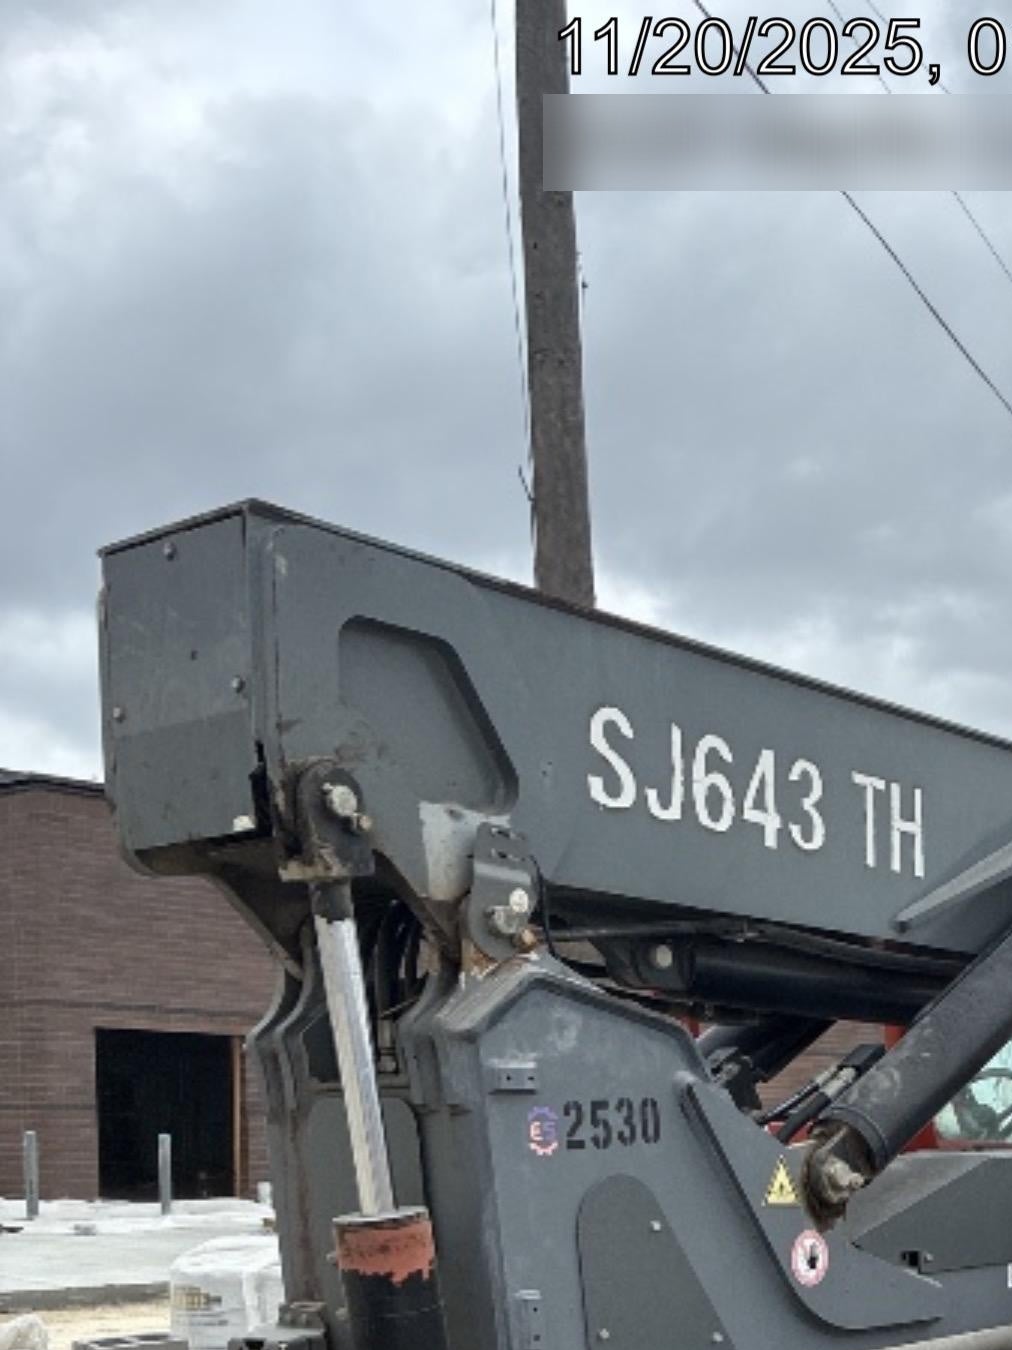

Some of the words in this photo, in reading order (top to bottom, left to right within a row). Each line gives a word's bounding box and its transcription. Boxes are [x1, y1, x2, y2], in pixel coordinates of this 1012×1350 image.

[587, 706, 826, 851] SJ643
[851, 771, 925, 879] TH
[563, 1097, 661, 1149] 2530
